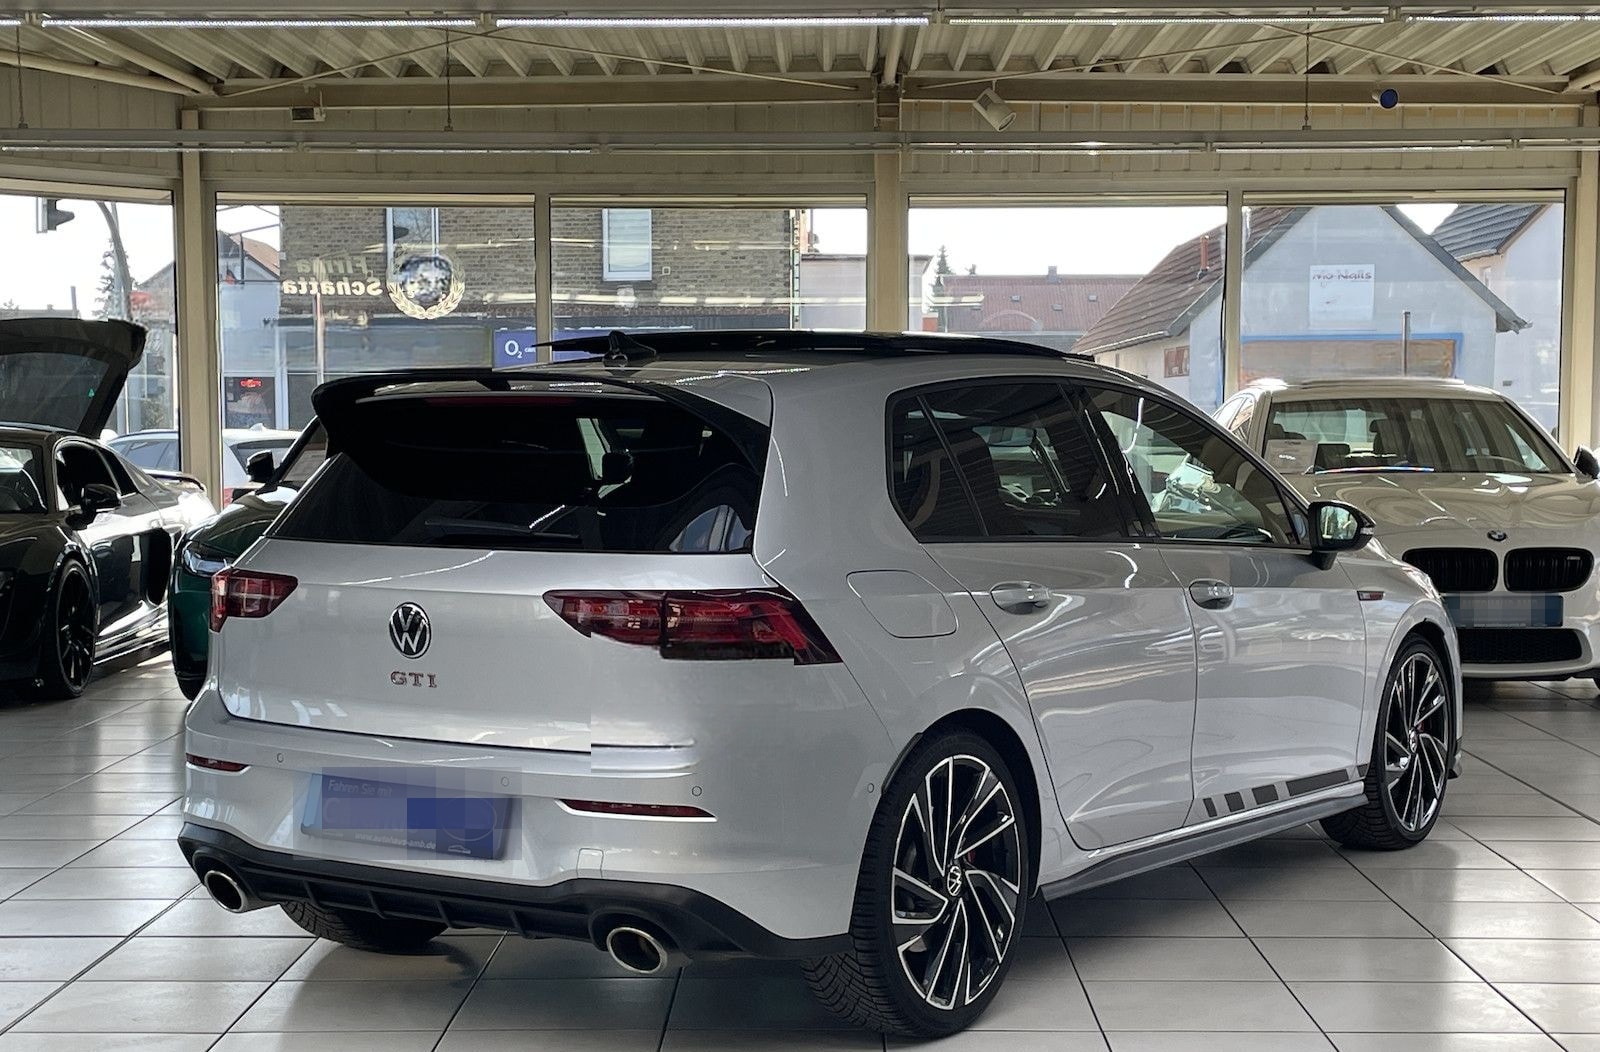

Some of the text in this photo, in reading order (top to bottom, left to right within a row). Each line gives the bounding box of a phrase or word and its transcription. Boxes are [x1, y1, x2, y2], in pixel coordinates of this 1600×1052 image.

[391, 671, 437, 688] GTI
[328, 779, 359, 793] Fahren
[377, 786, 392, 797] mit
